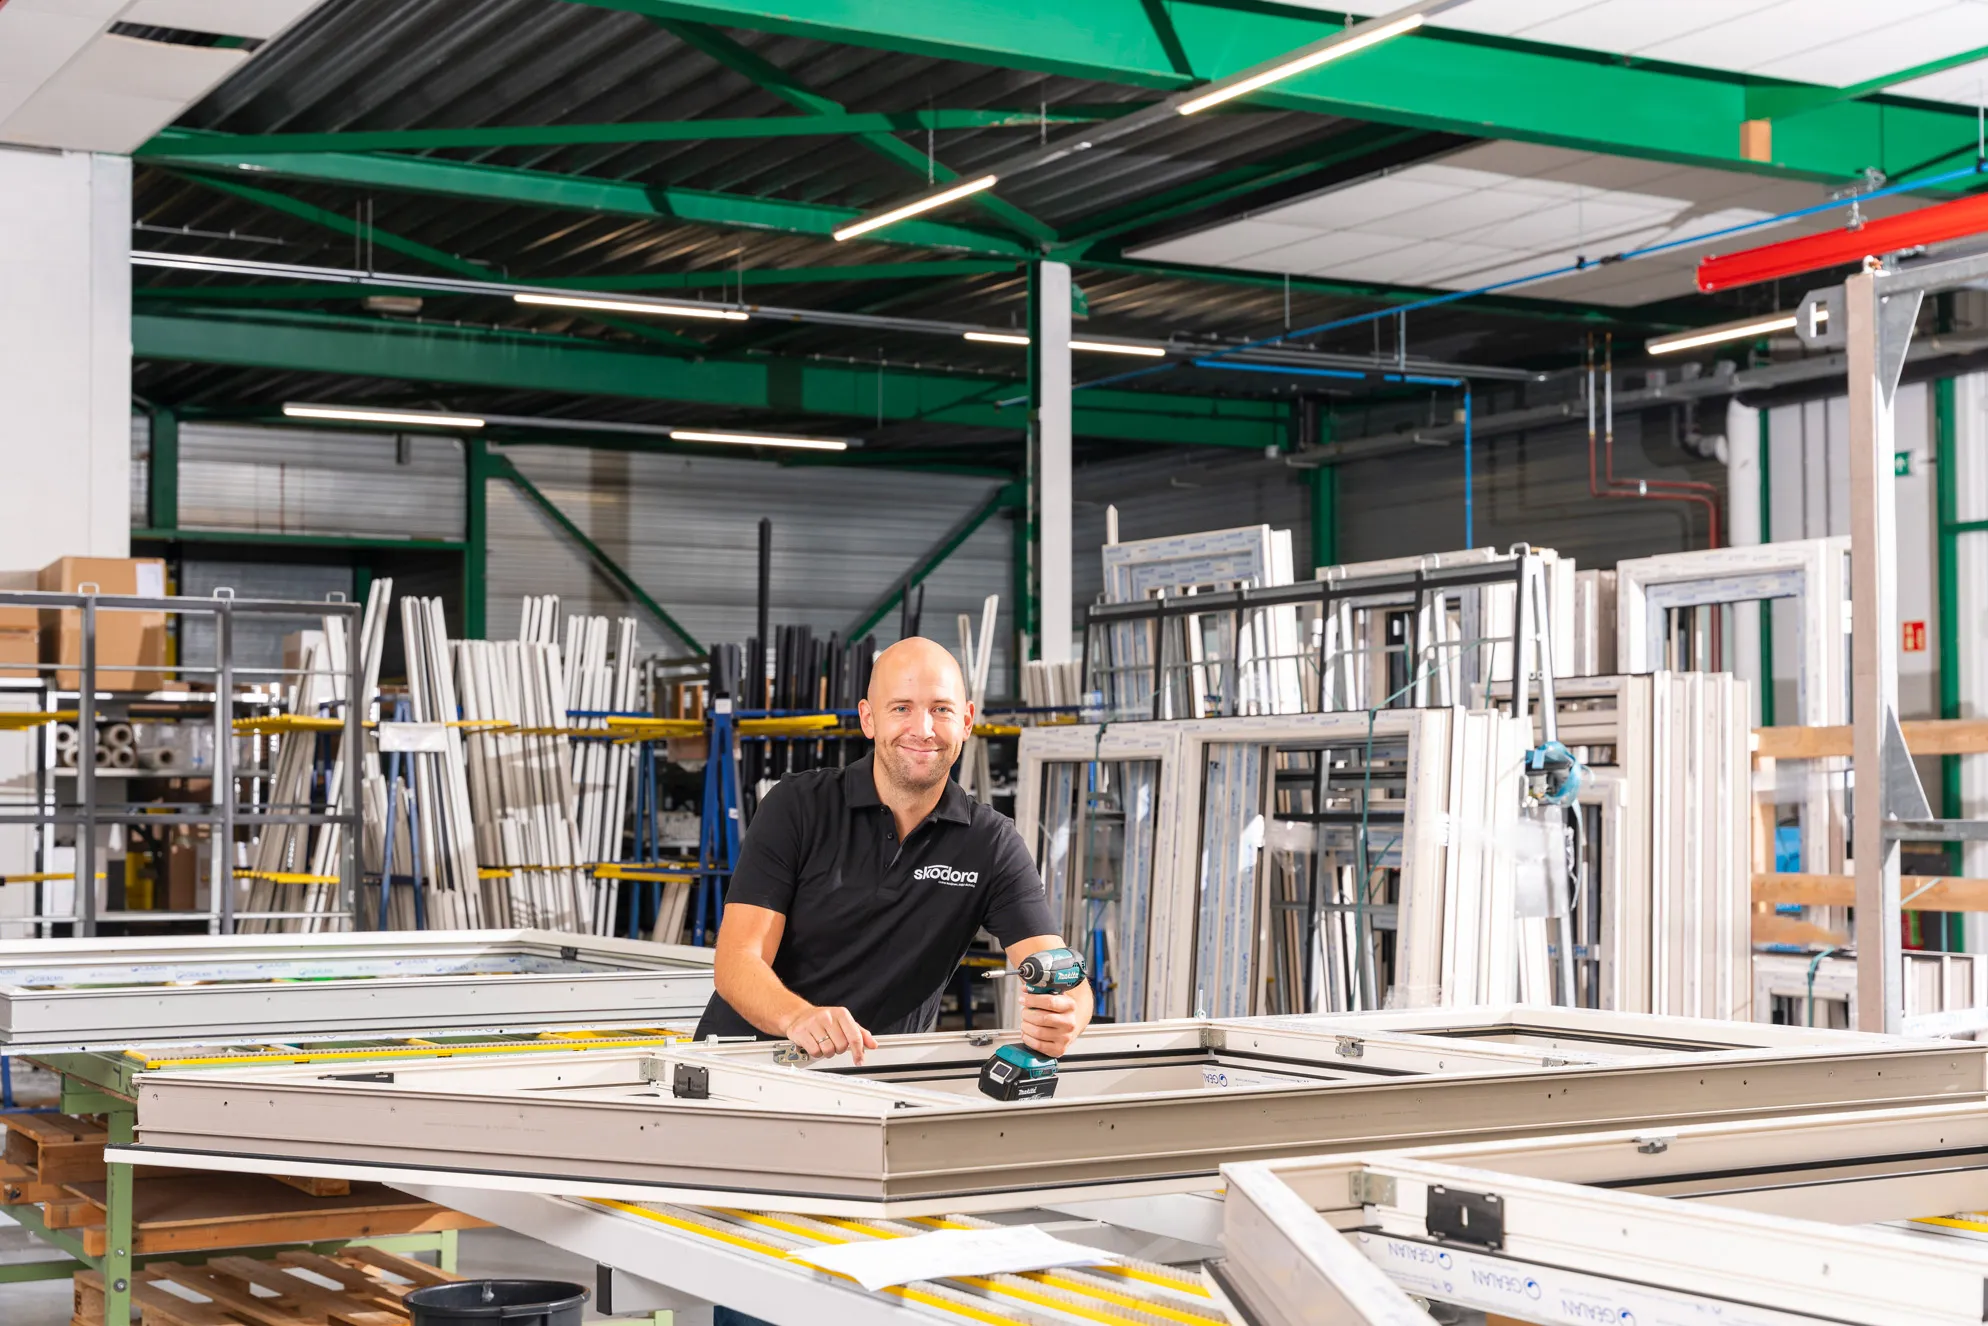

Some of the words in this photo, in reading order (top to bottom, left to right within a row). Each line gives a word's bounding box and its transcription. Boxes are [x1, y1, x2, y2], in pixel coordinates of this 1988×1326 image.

[913, 864, 979, 884] skodora
[1387, 1241, 1435, 1265] GEALAN
[1471, 1269, 1522, 1294] GEALAN
[1561, 1299, 1616, 1325] GEALAN
